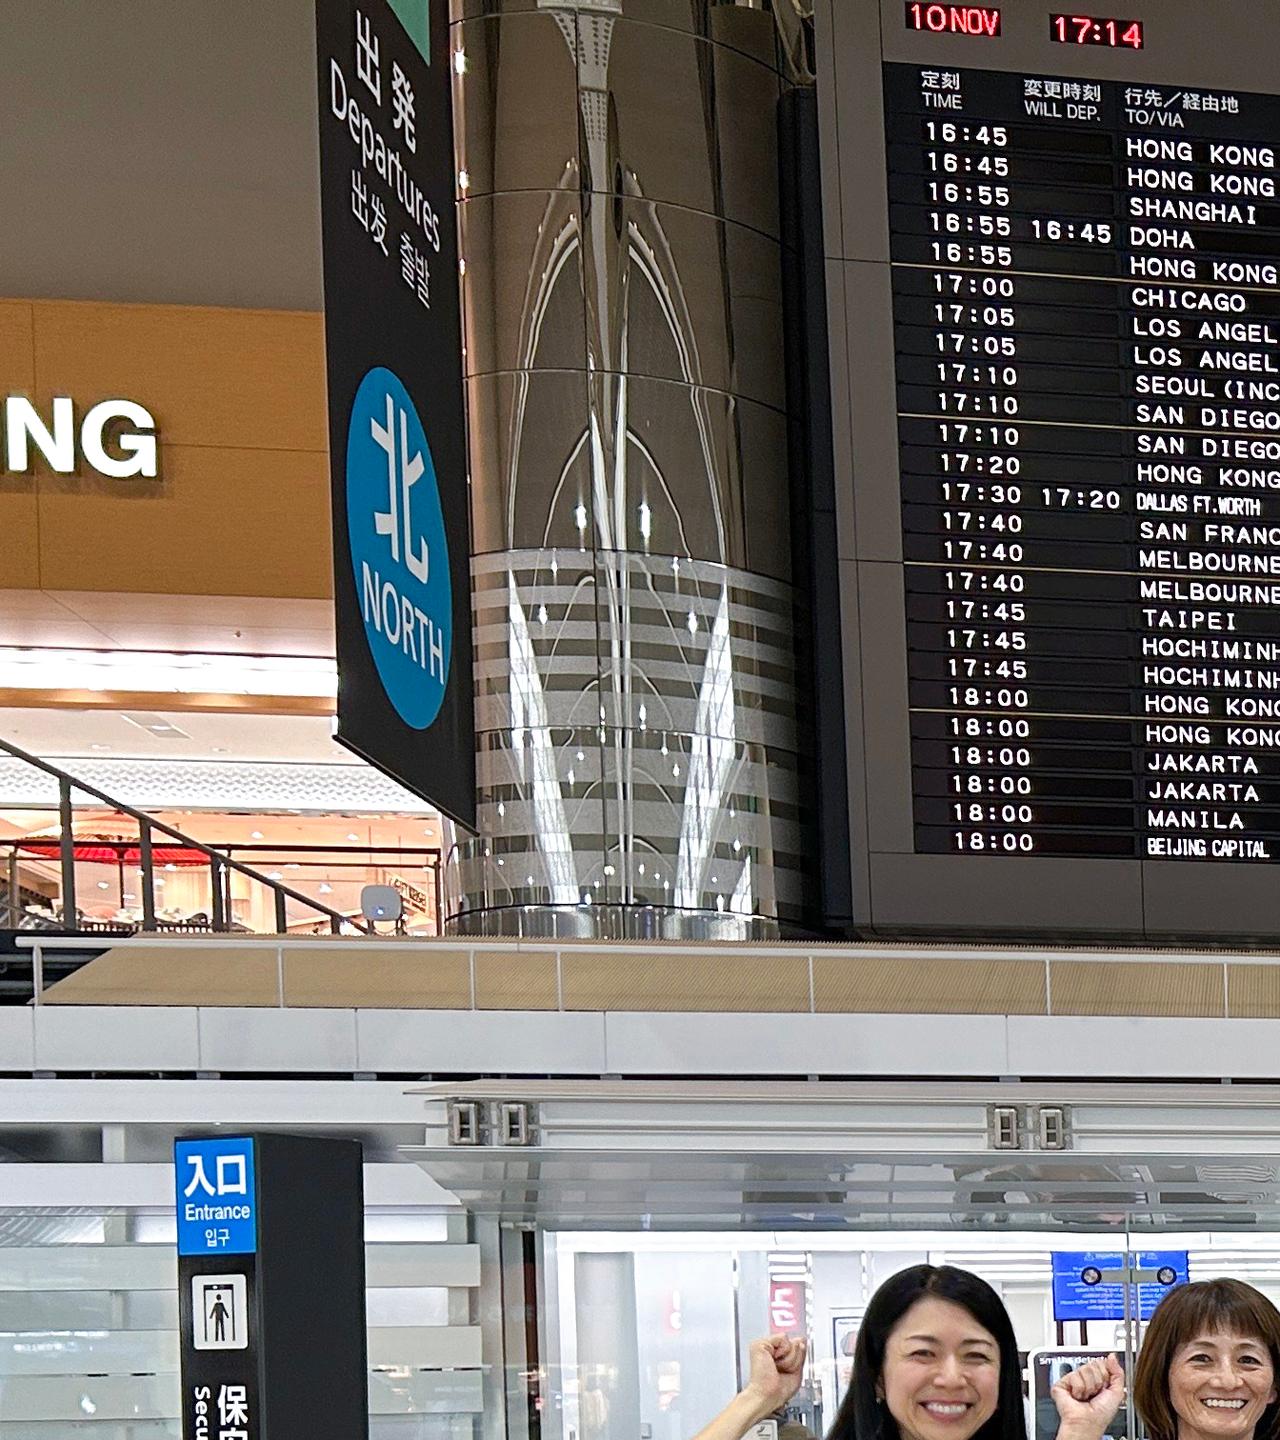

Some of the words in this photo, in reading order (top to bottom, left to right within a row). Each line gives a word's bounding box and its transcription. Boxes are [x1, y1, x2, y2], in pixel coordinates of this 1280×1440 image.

[1055, 17, 1142, 49] 17:14
[921, 70, 960, 91] 定刻
[1024, 79, 1101, 102] 変更時刻
[922, 92, 962, 110] TIME
[1024, 101, 1063, 118] WILL
[1067, 103, 1101, 121] DEP.
[1125, 109, 1184, 129] TO/VIA
[331, 57, 440, 252] Departures
[926, 121, 1008, 147] 16:45
[1126, 137, 1193, 162] HONG
[1209, 144, 1275, 168] KONG
[937, 363, 1017, 386] 17:10
[1135, 374, 1215, 398] SEOUL
[5, 396, 158, 478] NG
[361, 560, 445, 685] NORTH
[954, 803, 1033, 823] 18:00
[1147, 809, 1245, 830] MANILA
[184, 1154, 247, 1197] 入口
[185, 1204, 250, 1221] Entrance
[205, 1228, 230, 1247] 입구
